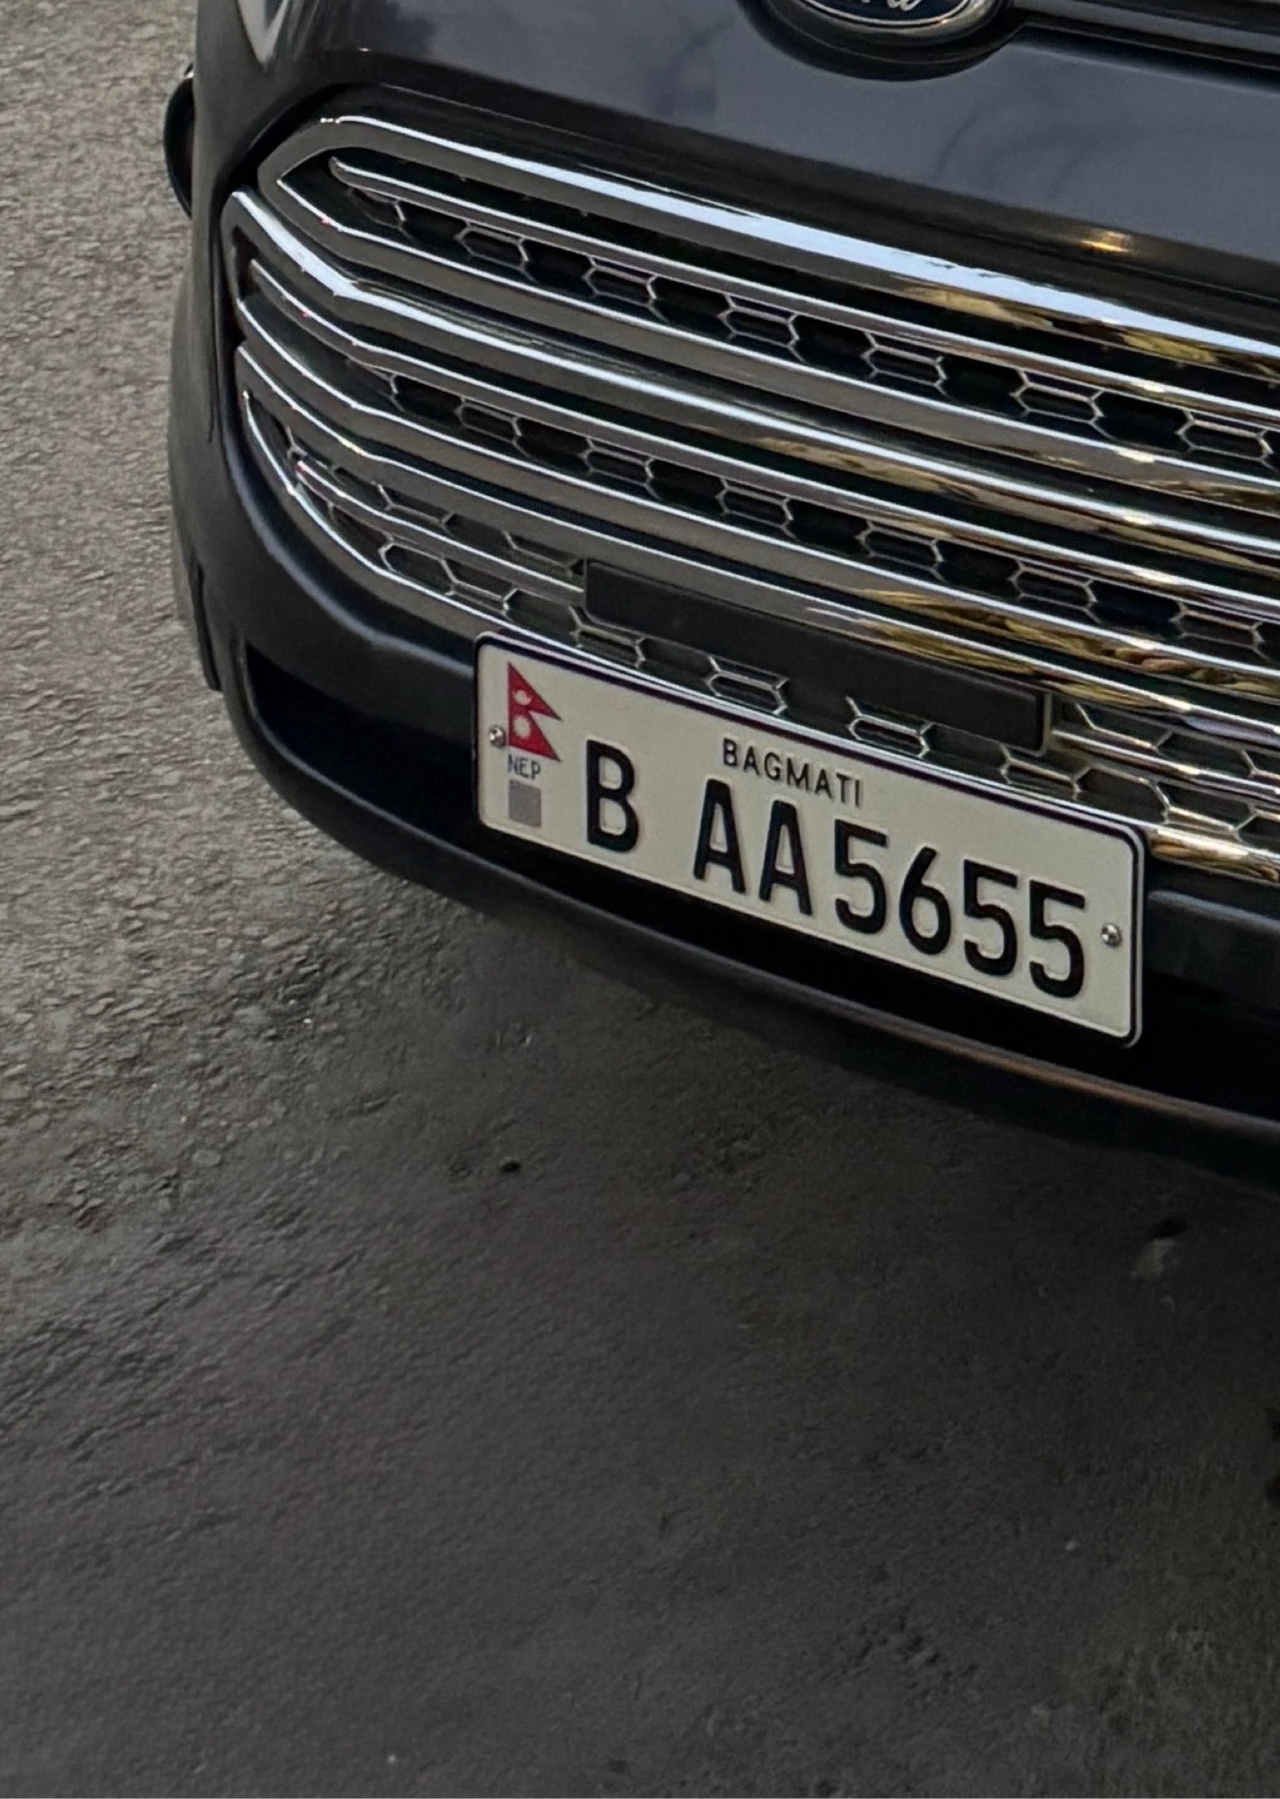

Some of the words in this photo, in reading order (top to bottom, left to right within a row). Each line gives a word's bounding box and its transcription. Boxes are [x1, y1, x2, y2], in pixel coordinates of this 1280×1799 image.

[508, 754, 541, 781] NEP
[586, 738, 640, 854] B
[722, 738, 862, 808] BAGMATI
